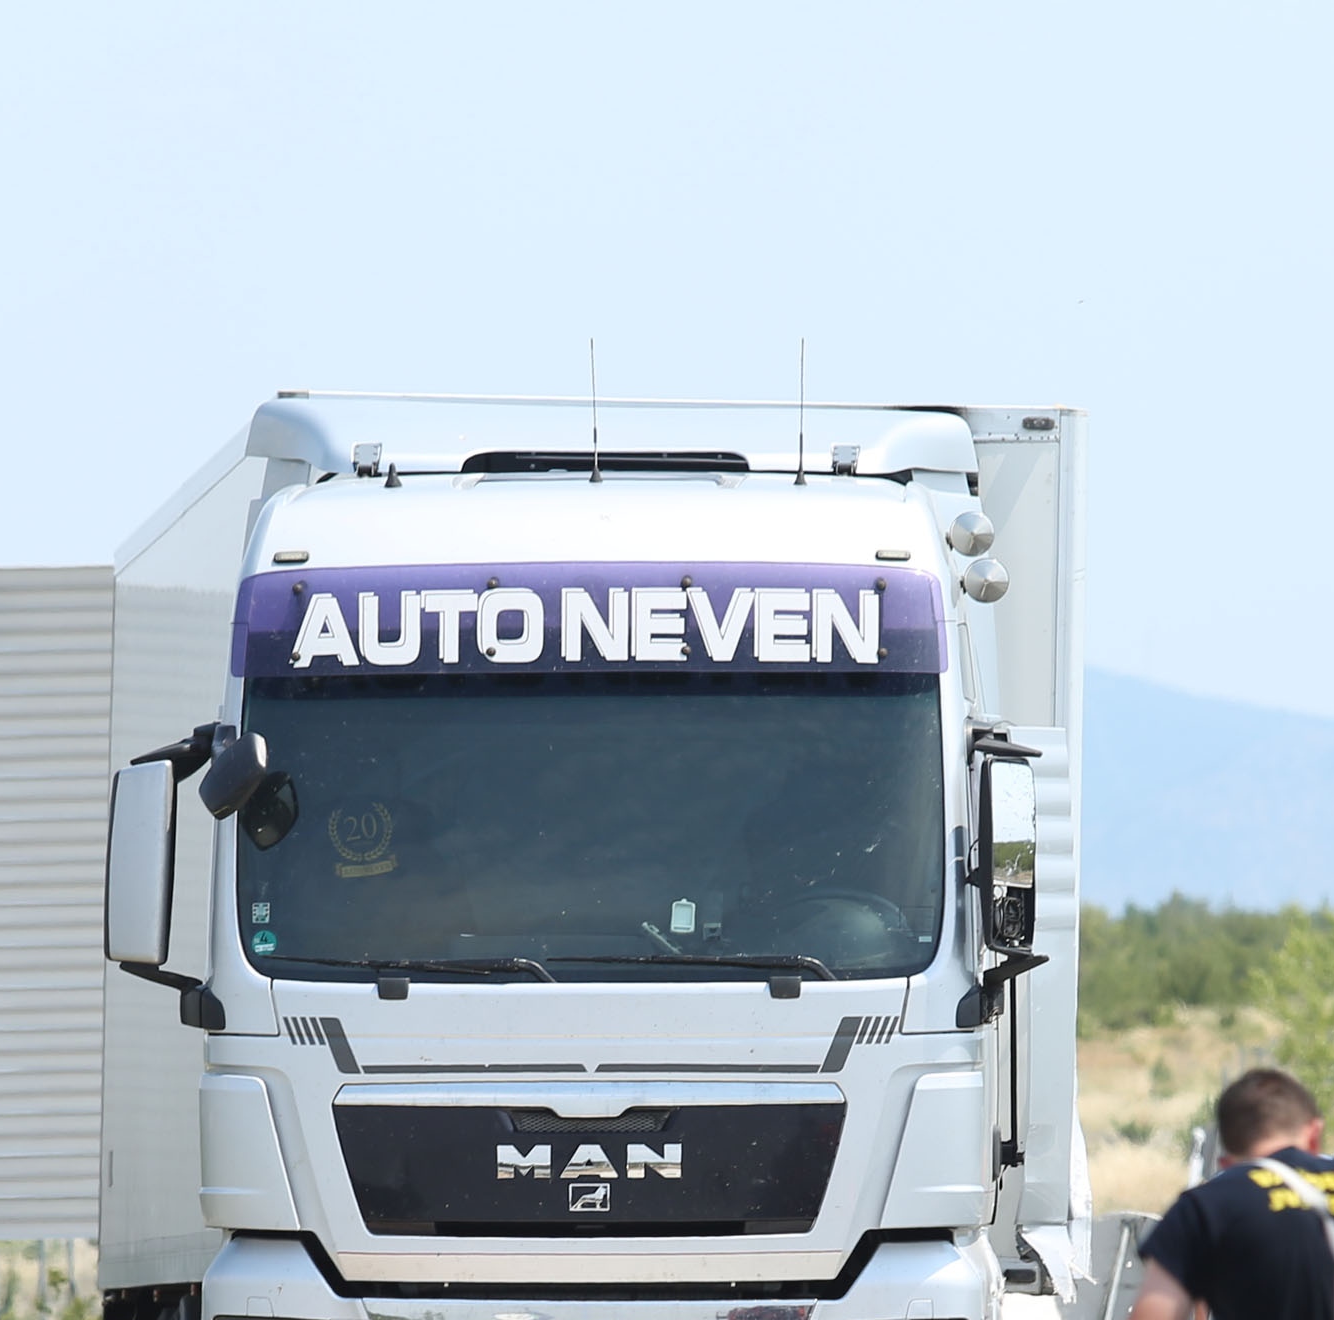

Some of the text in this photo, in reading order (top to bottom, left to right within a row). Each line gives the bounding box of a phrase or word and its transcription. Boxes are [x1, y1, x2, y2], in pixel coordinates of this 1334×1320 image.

[288, 586, 880, 669] AUTO NEVEN
[343, 812, 378, 842] 20
[496, 1143, 683, 1180] MAN
